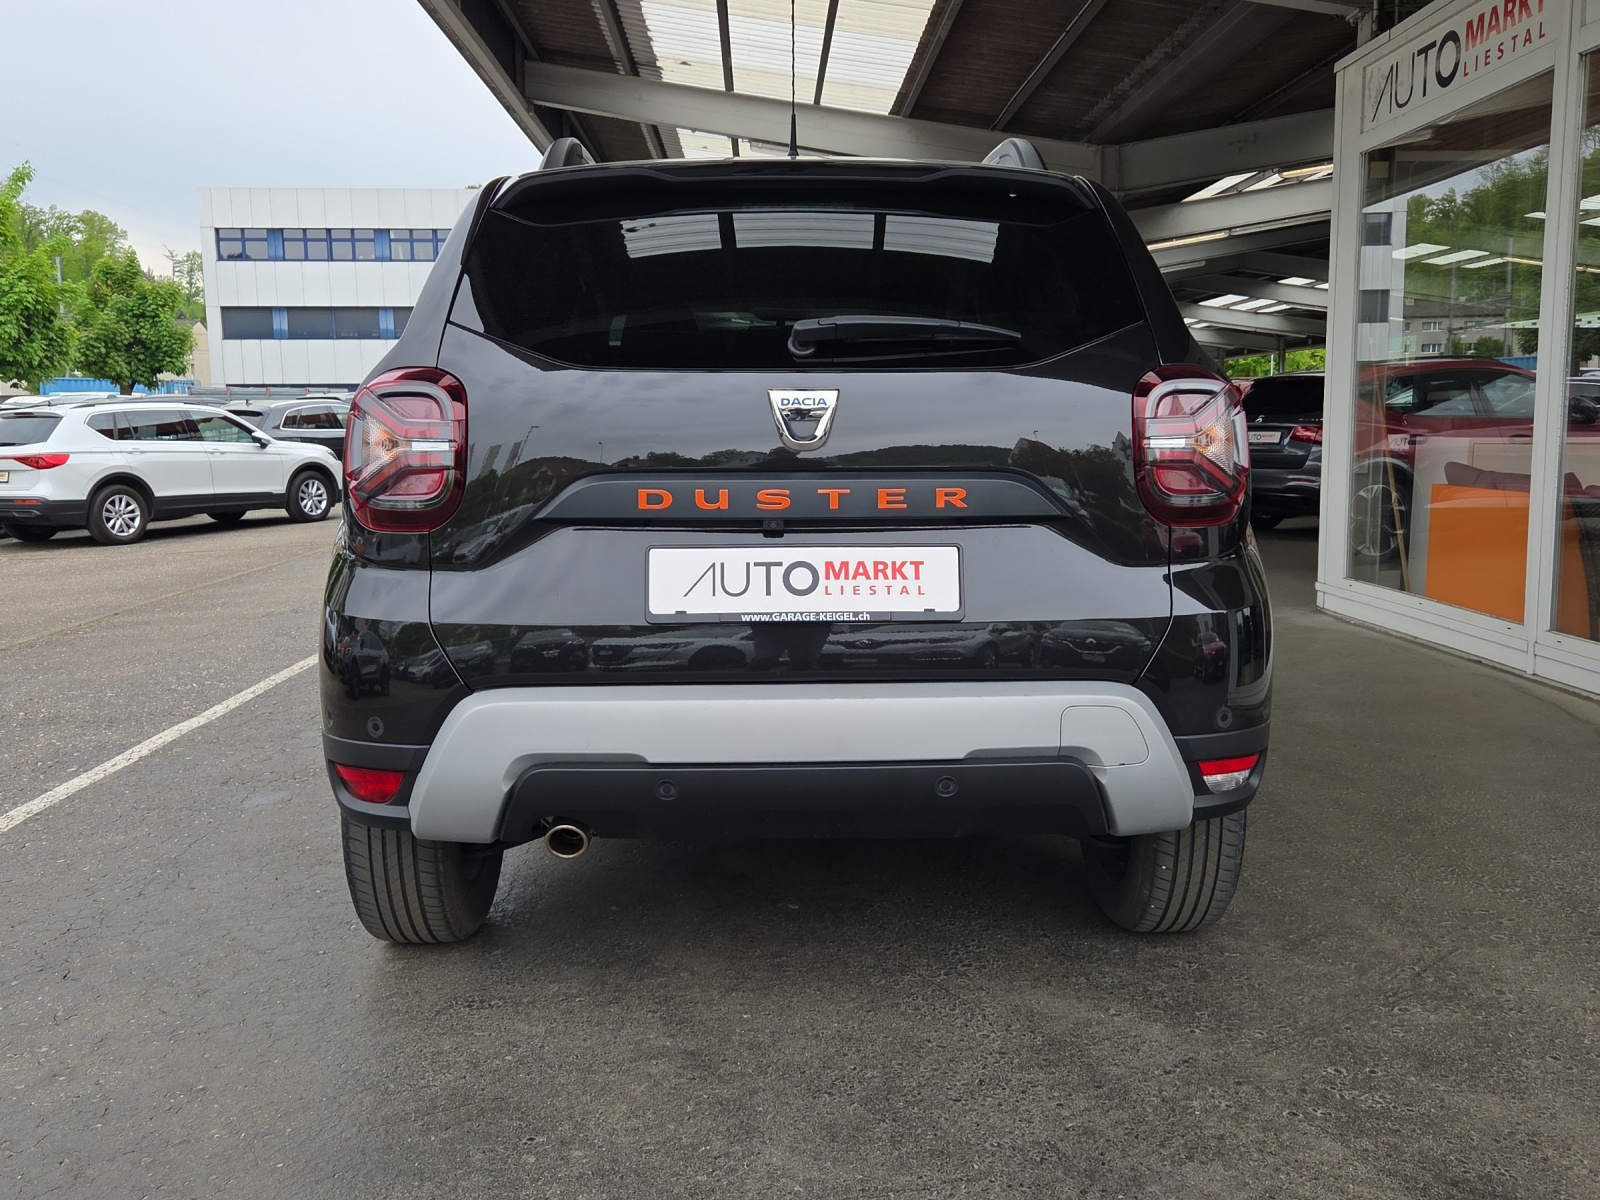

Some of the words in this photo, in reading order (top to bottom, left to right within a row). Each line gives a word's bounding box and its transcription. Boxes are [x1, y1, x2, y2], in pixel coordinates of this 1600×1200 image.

[1463, 22, 1545, 77] LIESTAL
[1372, 30, 1461, 122] AUTO
[781, 397, 827, 406] DACIA
[637, 488, 968, 509] DUSTER
[683, 560, 819, 597] AUTO
[825, 560, 924, 581] MARKT
[825, 585, 925, 596] LIESTAL
[741, 612, 870, 622] www.GARAGE-KEIGEL.ch
